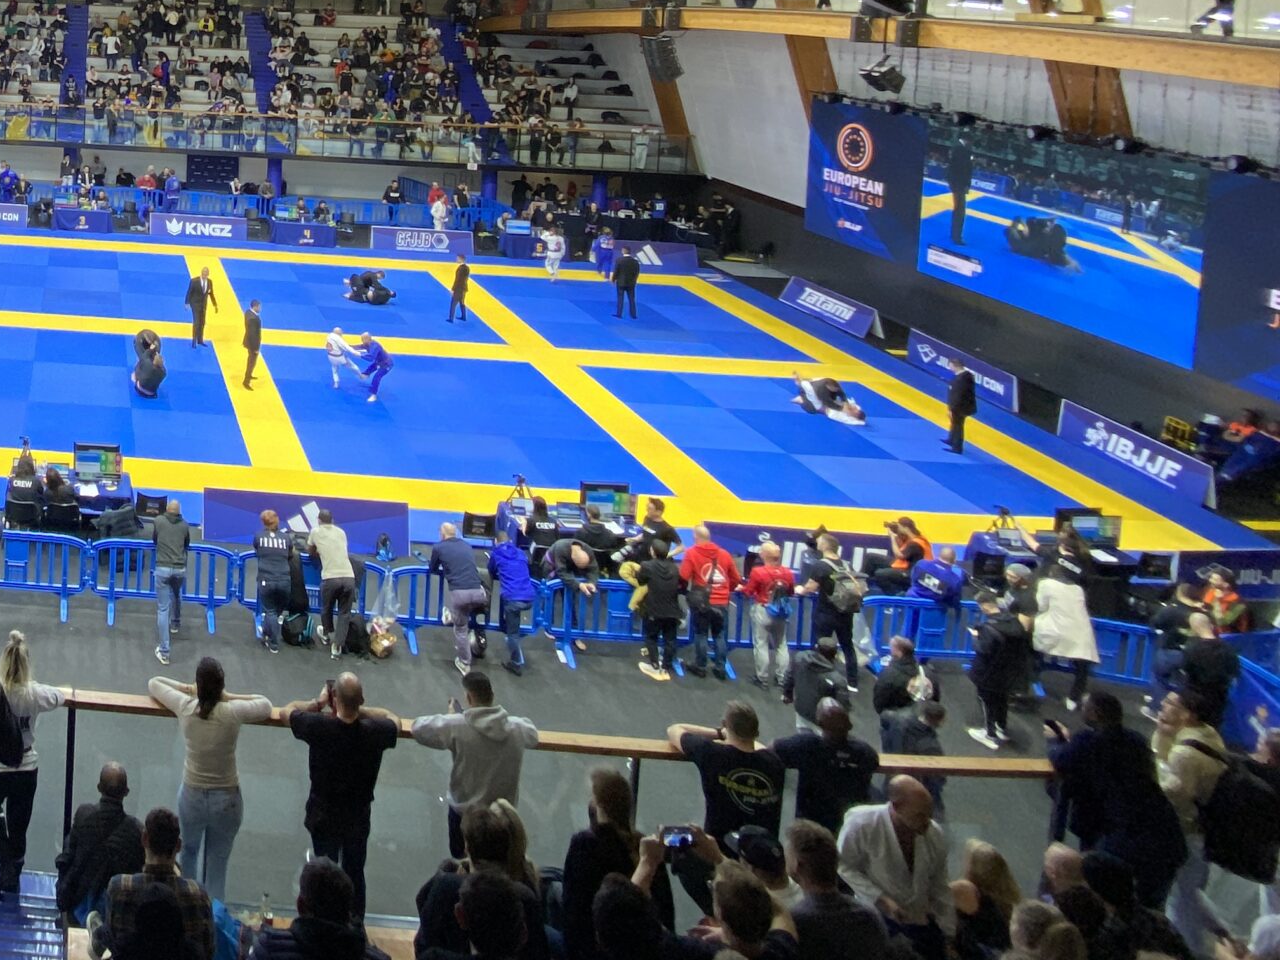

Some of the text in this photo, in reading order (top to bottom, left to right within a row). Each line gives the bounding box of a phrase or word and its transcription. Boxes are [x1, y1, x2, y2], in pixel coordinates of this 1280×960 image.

[823, 168, 884, 196] EUROPEAN
[823, 183, 883, 208] JIU-JITSU
[2, 212, 19, 222] CON
[396, 230, 432, 248] CFJJB
[799, 287, 857, 321] Tatami
[1106, 433, 1183, 480] IBJJF
[13, 480, 33, 489] CREW
[535, 522, 556, 530] CREW
